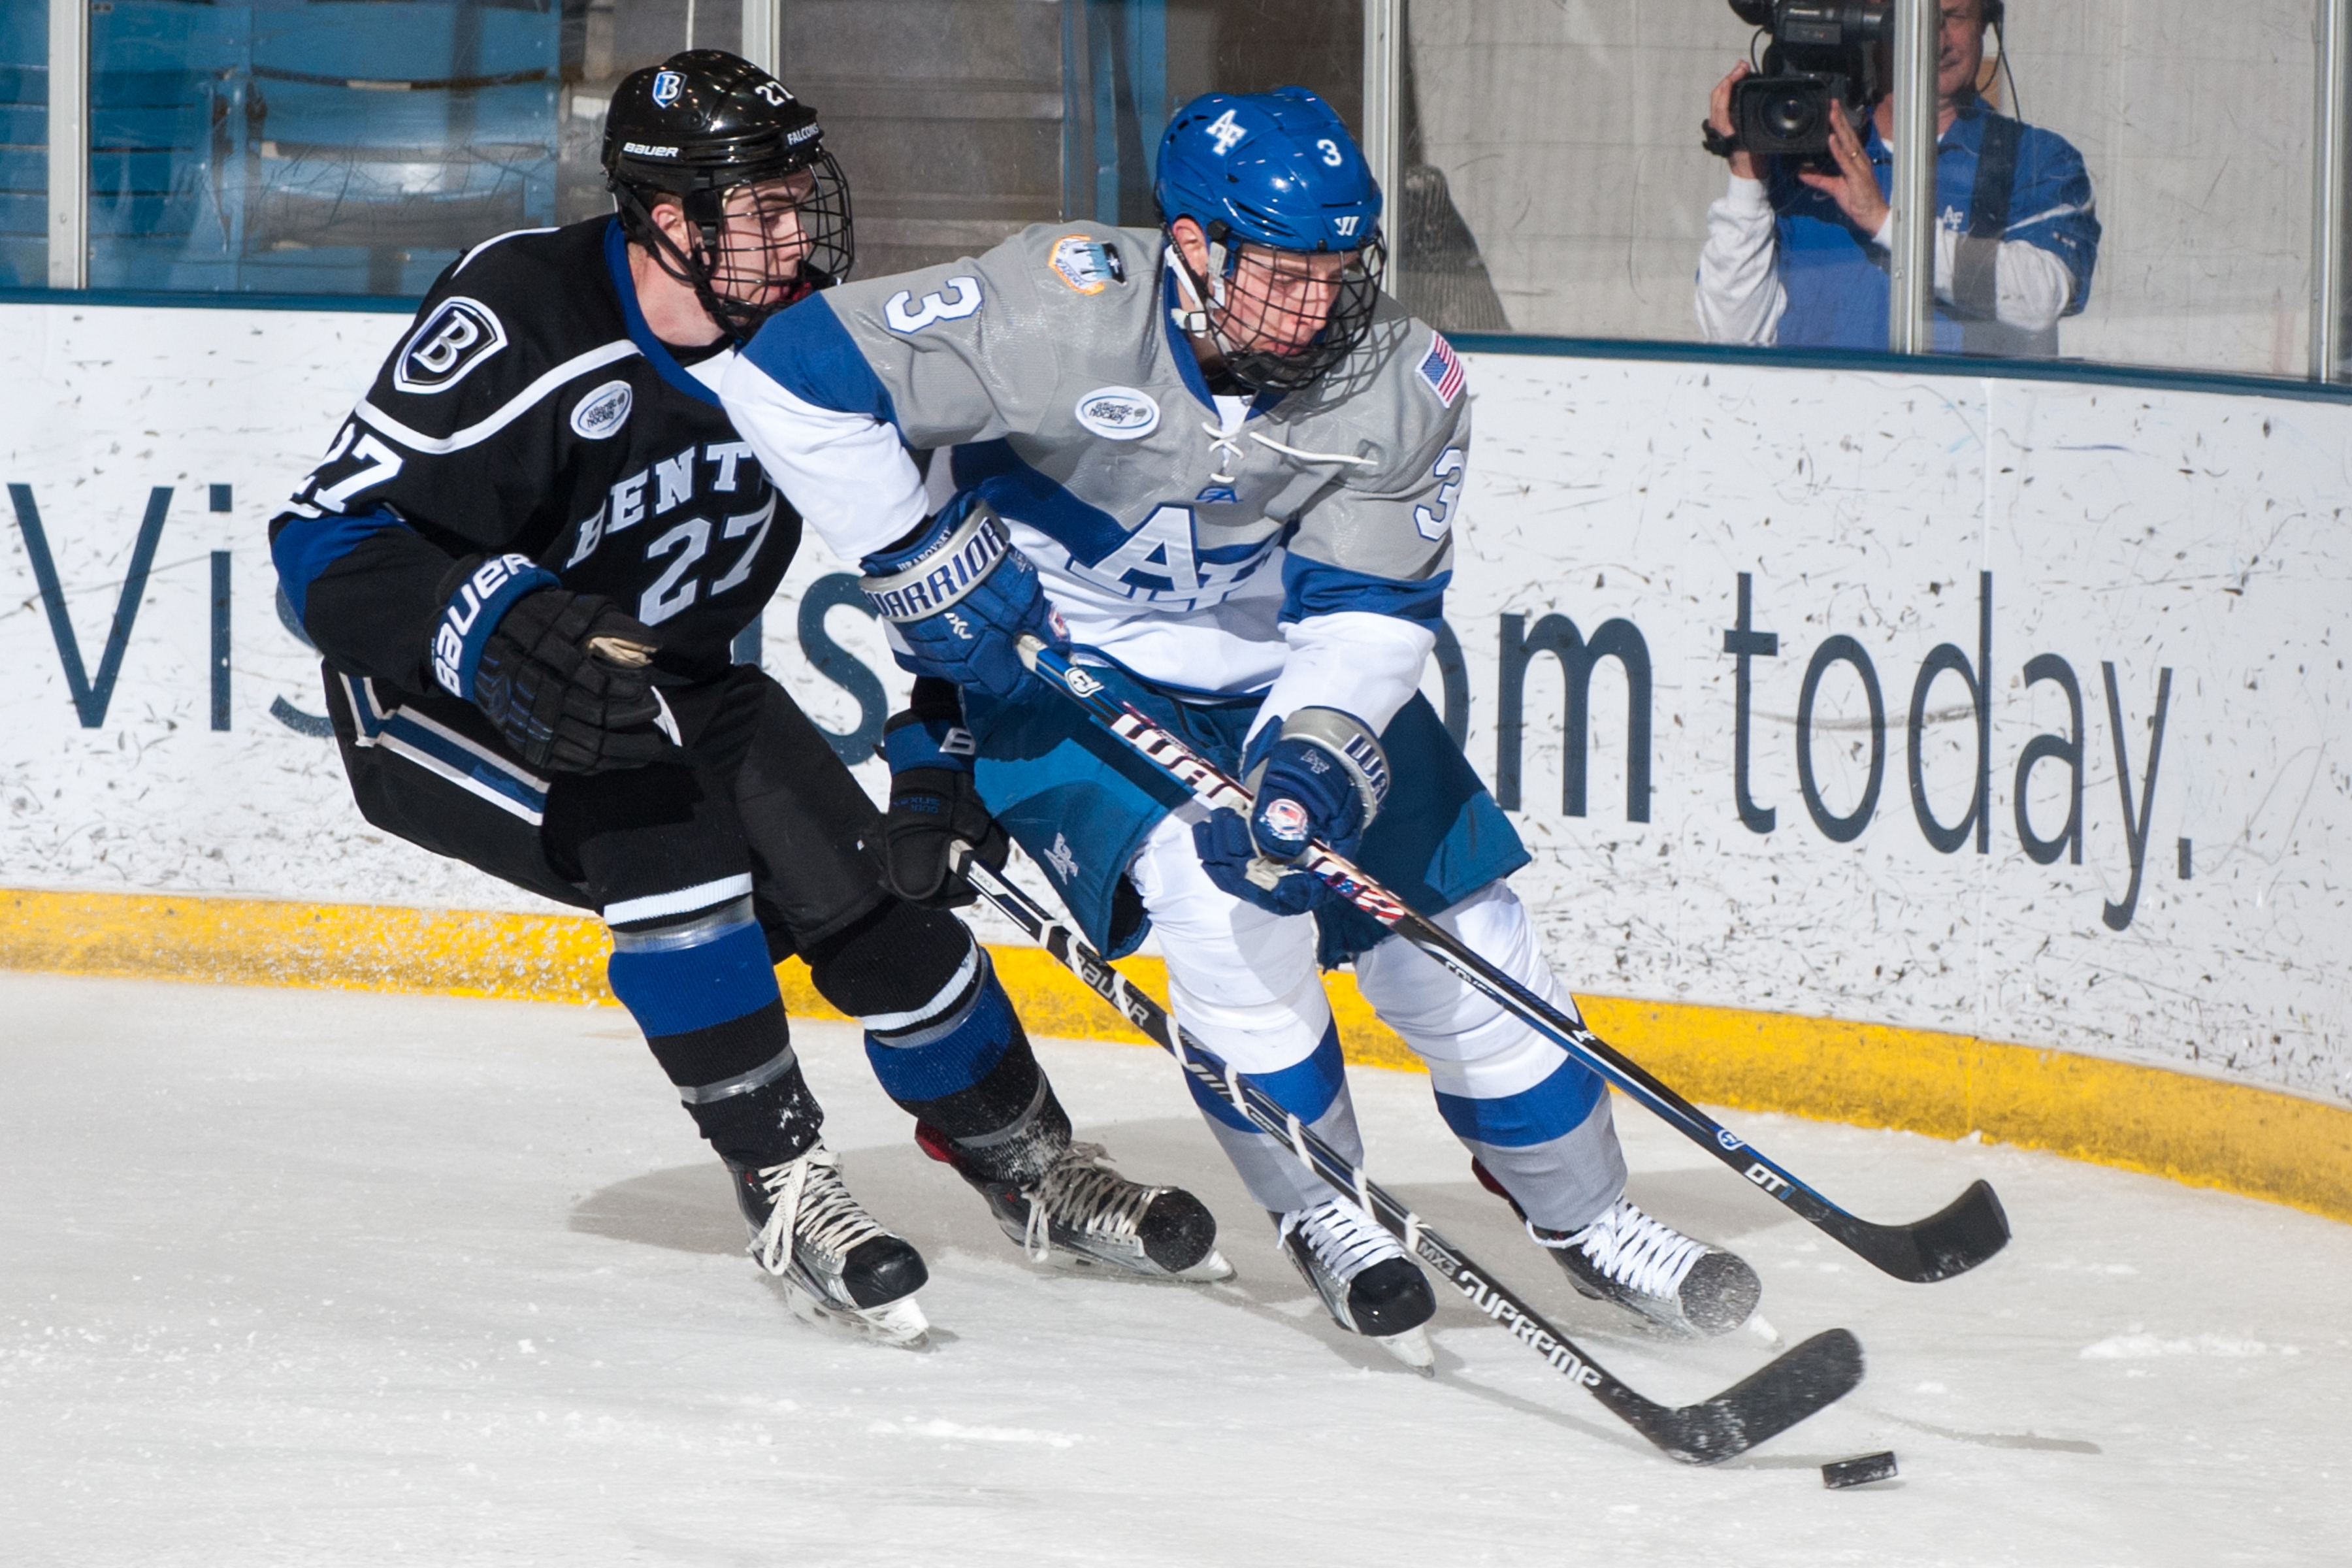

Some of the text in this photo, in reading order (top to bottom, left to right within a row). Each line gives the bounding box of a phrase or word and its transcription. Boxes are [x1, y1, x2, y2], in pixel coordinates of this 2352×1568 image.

[657, 74, 680, 99] B
[755, 81, 794, 106] 27
[787, 122, 819, 146] FALCONS
[1316, 139, 1343, 167] 3
[410, 310, 478, 374] B
[883, 275, 984, 335] 3
[269, 422, 405, 520] 27
[1414, 447, 1468, 542] 3
[637, 488, 777, 627] 27
[861, 515, 1007, 619] WARRIOR
[435, 553, 538, 698] BAUER
[1723, 570, 2193, 932] today.
[1418, 1241, 1457, 1276] MX3
[1458, 1270, 1603, 1387] SUPREME
